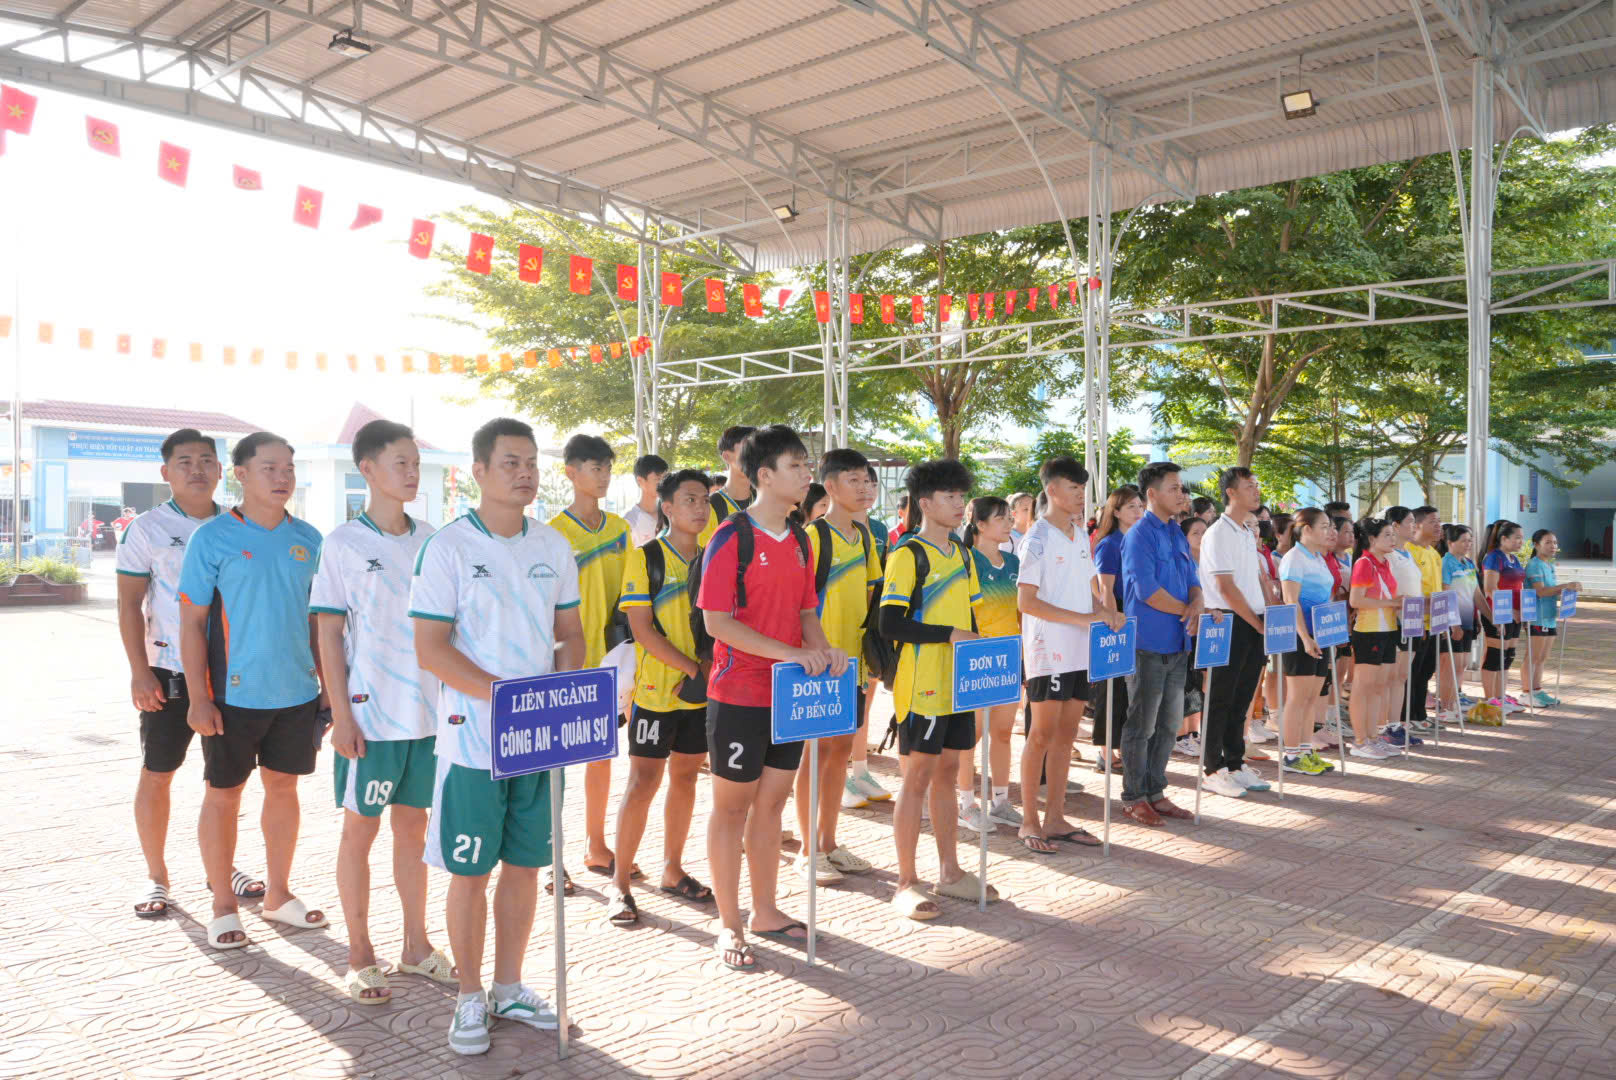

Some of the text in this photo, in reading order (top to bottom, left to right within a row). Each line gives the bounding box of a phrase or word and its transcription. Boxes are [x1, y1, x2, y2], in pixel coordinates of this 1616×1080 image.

[1100, 633, 1127, 648] ĐƠN VỊ
[969, 654, 1008, 672] ĐƠN VỊ
[792, 679, 840, 698] ĐƠN VỊ
[958, 675, 970, 693] ẤP
[1001, 671, 1017, 686] ĐÀO
[1051, 673, 1061, 692] 5
[511, 681, 598, 714] LIÊN NGÀNH
[790, 701, 804, 721] ẤP
[806, 699, 826, 719] BẾN
[500, 725, 532, 758] CÔNG
[534, 725, 551, 752] AN
[561, 715, 591, 750] QUÂN
[593, 714, 609, 746] SỰ
[636, 718, 660, 745] 04
[923, 715, 937, 741] 7
[727, 741, 744, 770] 2
[364, 780, 393, 805] 09
[452, 833, 482, 864] 21
